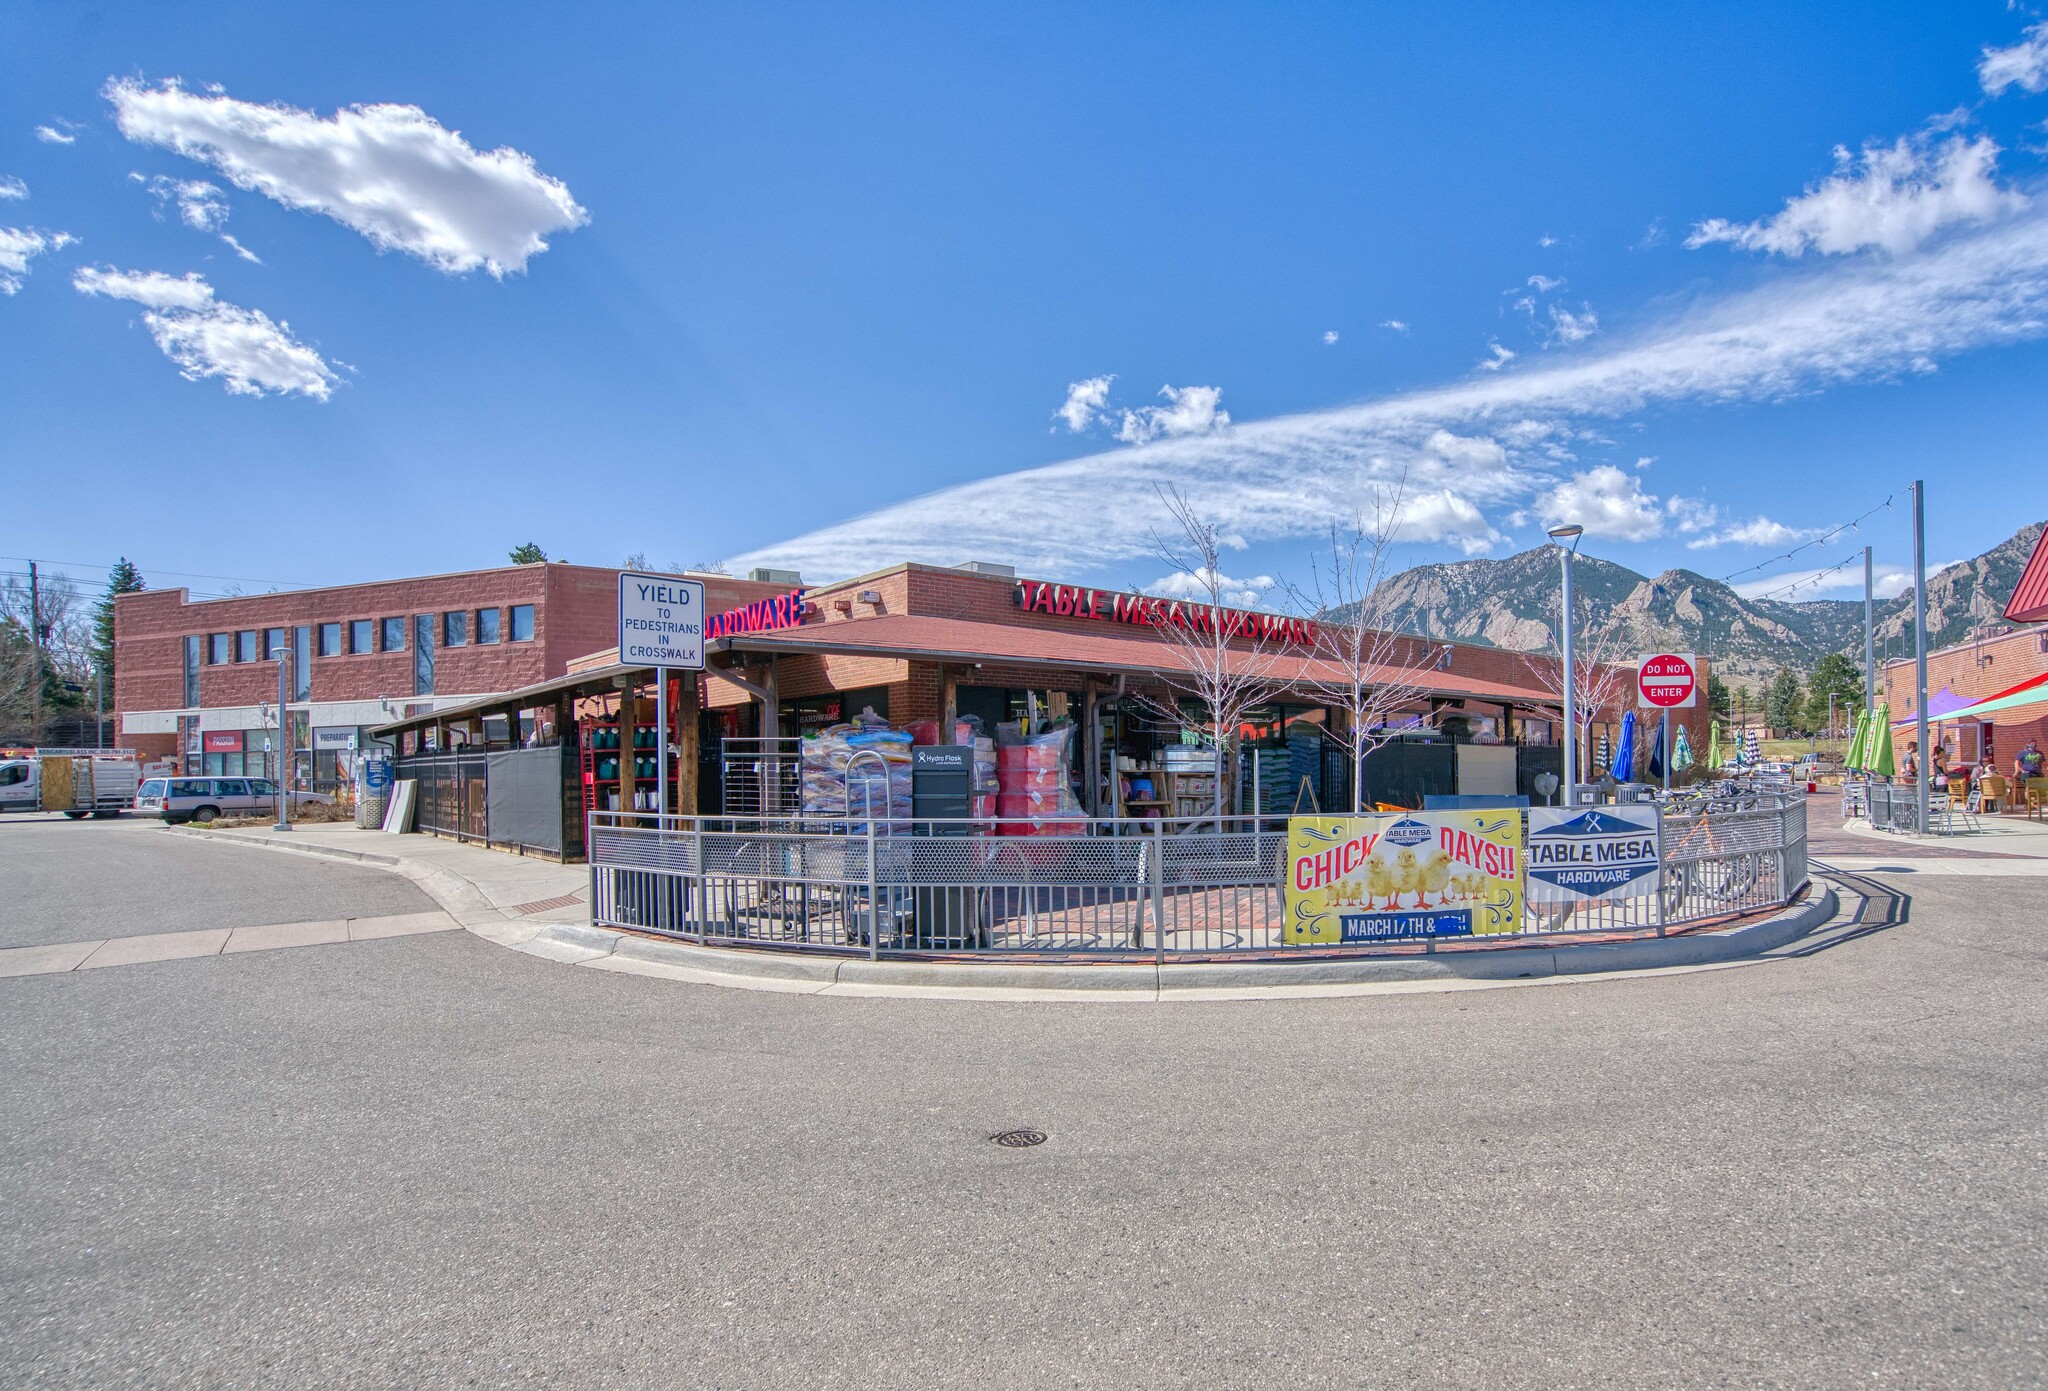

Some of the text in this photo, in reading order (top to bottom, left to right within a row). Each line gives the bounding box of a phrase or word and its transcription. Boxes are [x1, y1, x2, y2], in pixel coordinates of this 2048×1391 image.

[637, 584, 690, 605] YIELD
[657, 608, 671, 619] TO
[705, 589, 802, 640] HARDWARE
[1019, 579, 1317, 646] TABLE MESA HARDWARE
[625, 619, 700, 635] PEDESTRIANS
[658, 634, 670, 645] IN
[629, 645, 696, 660] CROSSWALK
[1647, 664, 1687, 674] DO NOT
[1651, 688, 1683, 697] ENTER
[213, 735, 235, 746] PASSION
[926, 755, 944, 763] Hydro
[1439, 826, 1516, 880] DAYS!!
[1530, 840, 1656, 863] TABLE MESA
[1295, 833, 1379, 891] CHICK
[1557, 869, 1631, 884] HARDWARE
[1348, 918, 1391, 936] MARCH
[1426, 917, 1436, 933] &
